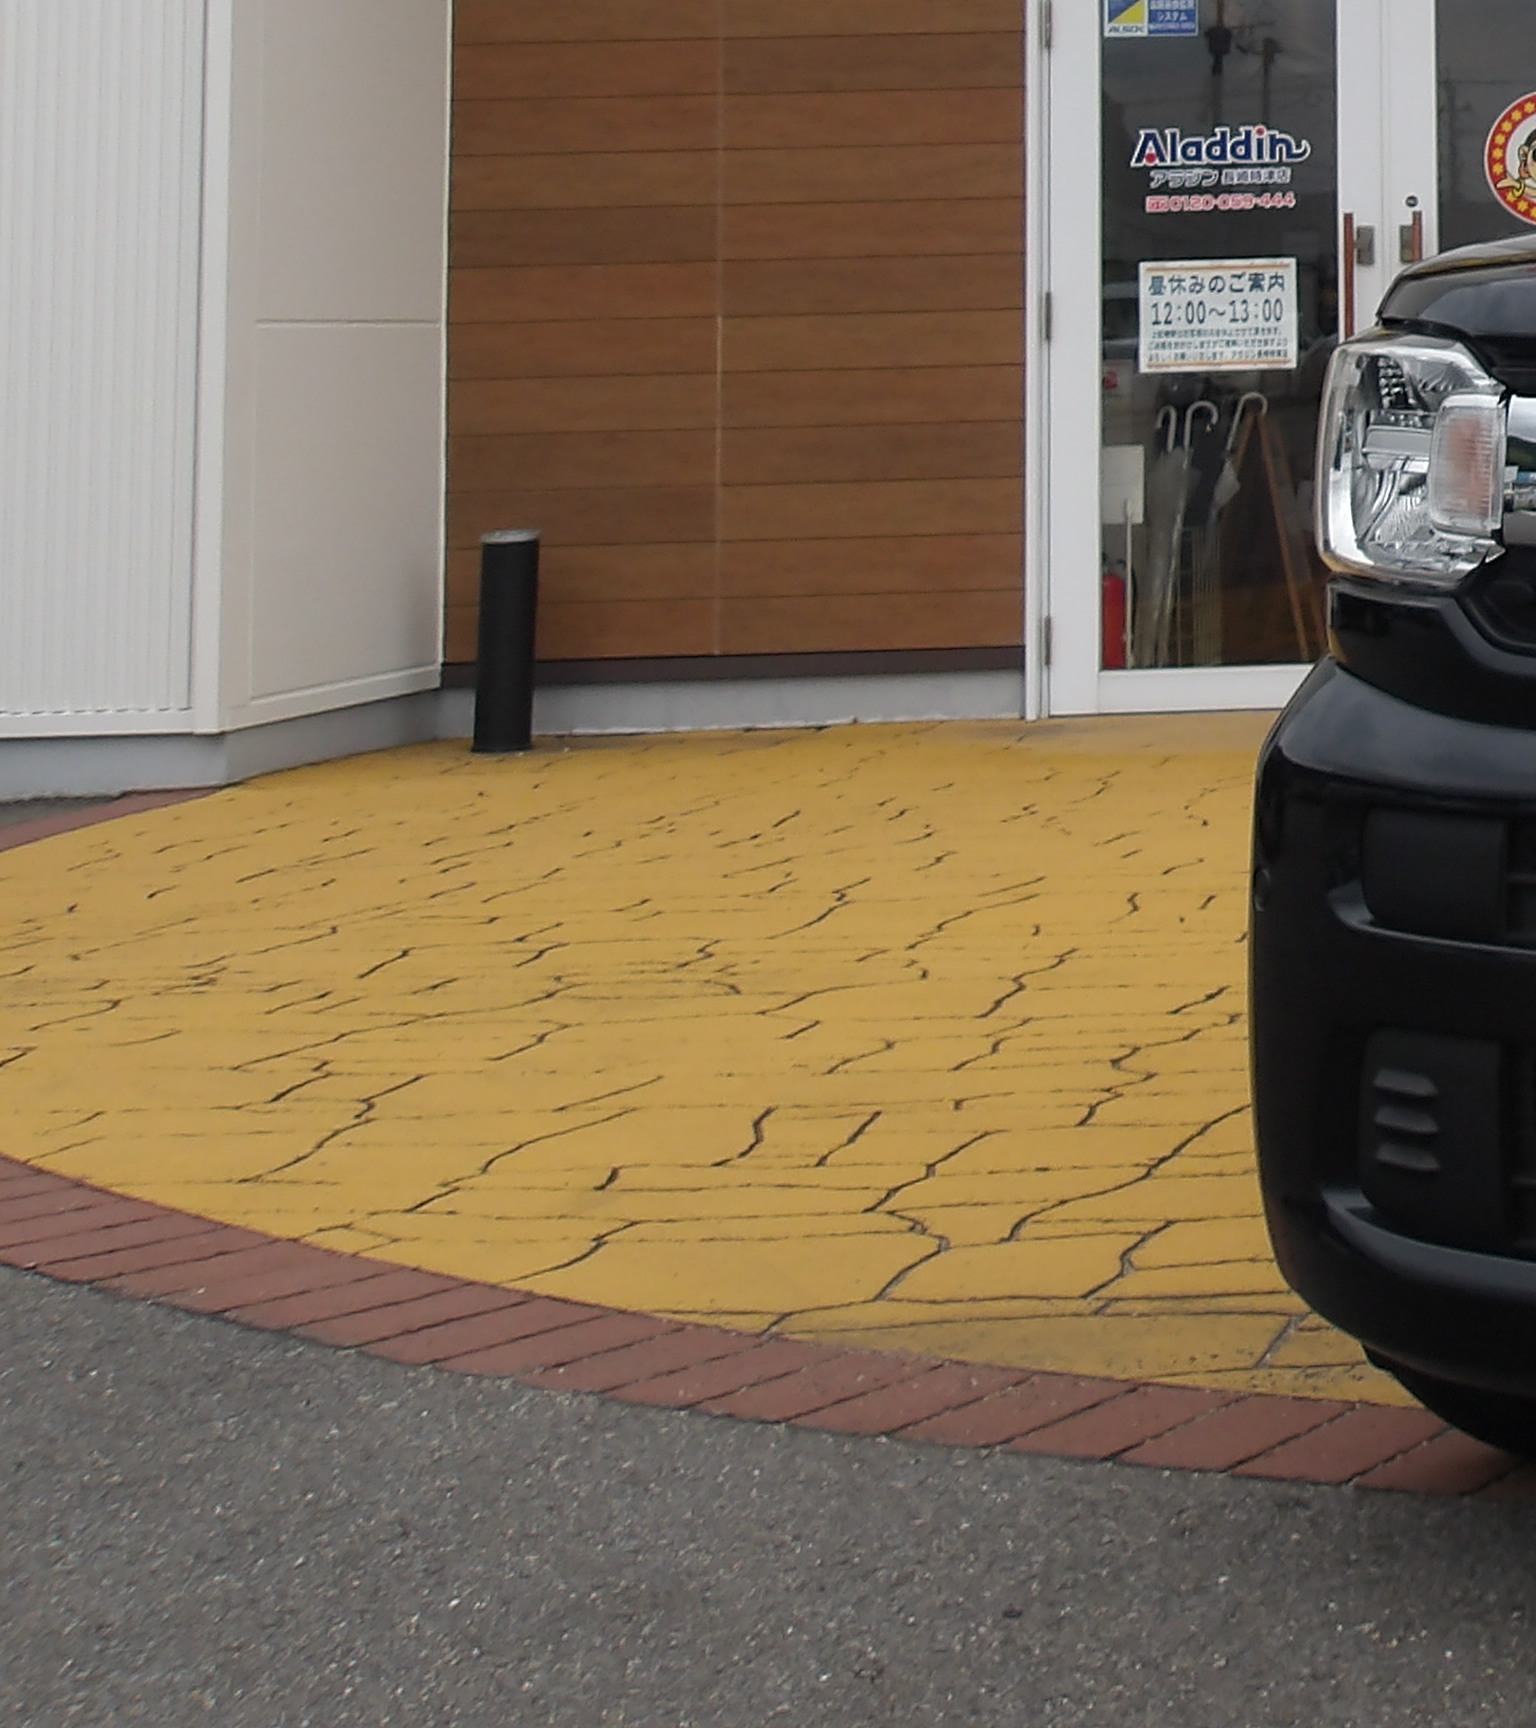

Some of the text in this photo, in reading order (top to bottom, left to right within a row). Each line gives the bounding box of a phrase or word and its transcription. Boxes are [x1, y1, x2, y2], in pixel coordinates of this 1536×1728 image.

[1130, 124, 1311, 167] Aladdin
[1149, 272, 1286, 296] 昼休みのご案内
